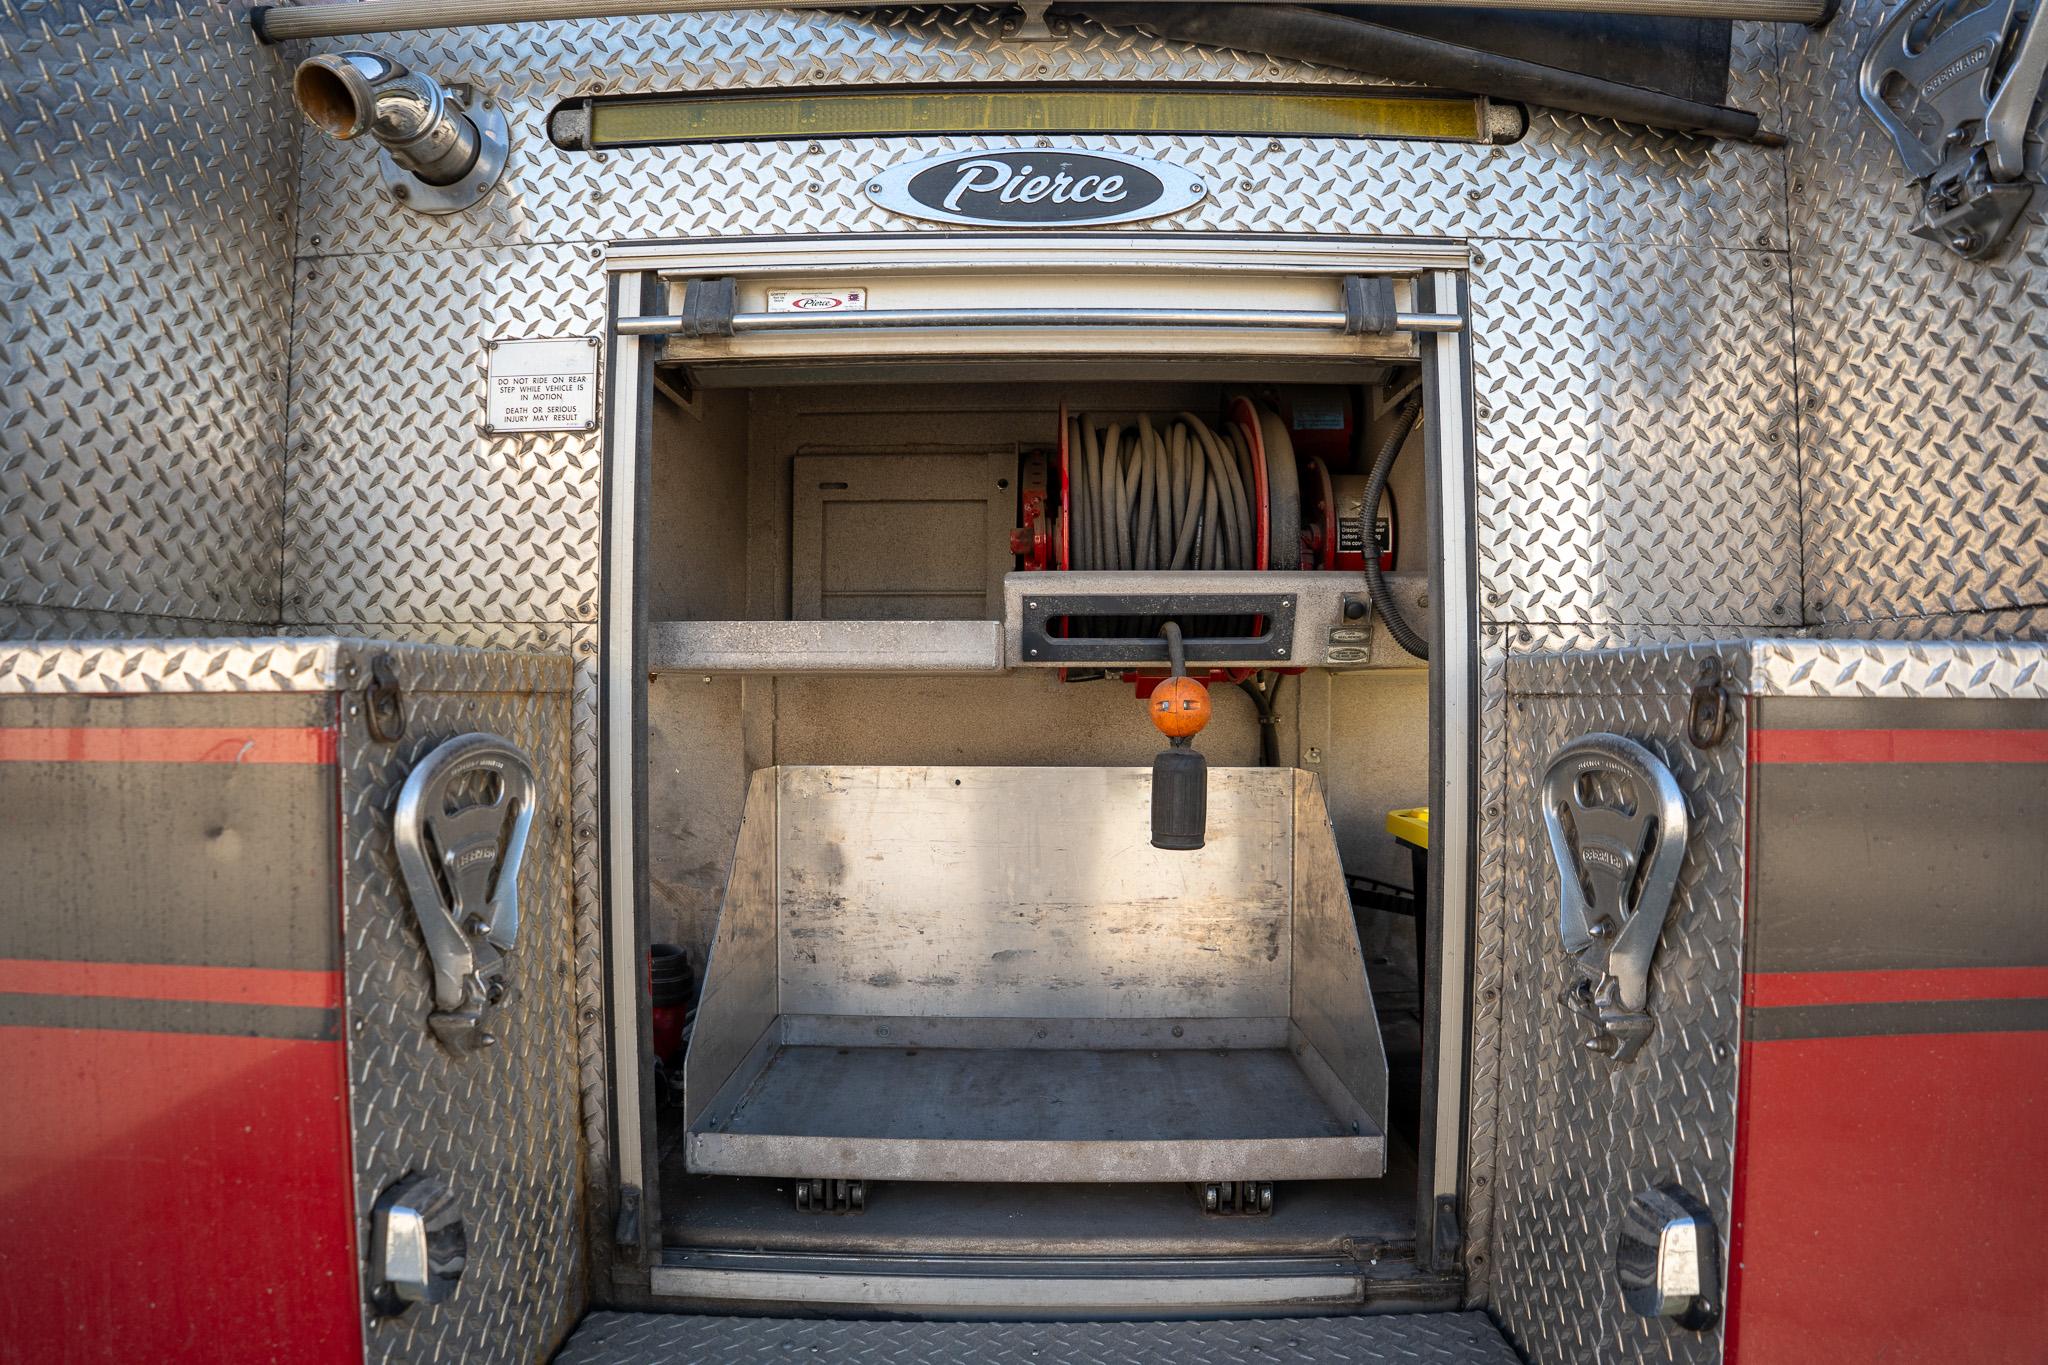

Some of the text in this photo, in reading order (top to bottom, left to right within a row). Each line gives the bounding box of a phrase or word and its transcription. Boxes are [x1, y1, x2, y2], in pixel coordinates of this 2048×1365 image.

[1926, 50, 1986, 92] EBERHARD
[943, 160, 1128, 211] Pierce
[804, 299, 832, 308] Pierce
[498, 375, 587, 386] DO NOT RIDE ON REAR
[499, 386, 516, 394] STEP
[519, 385, 541, 393] WHILE
[545, 384, 573, 392] VEHICLE
[532, 393, 563, 401] MOTION
[505, 405, 577, 415] DEATH OR SERIOUS
[504, 413, 578, 423] INJURY MAY RESULT
